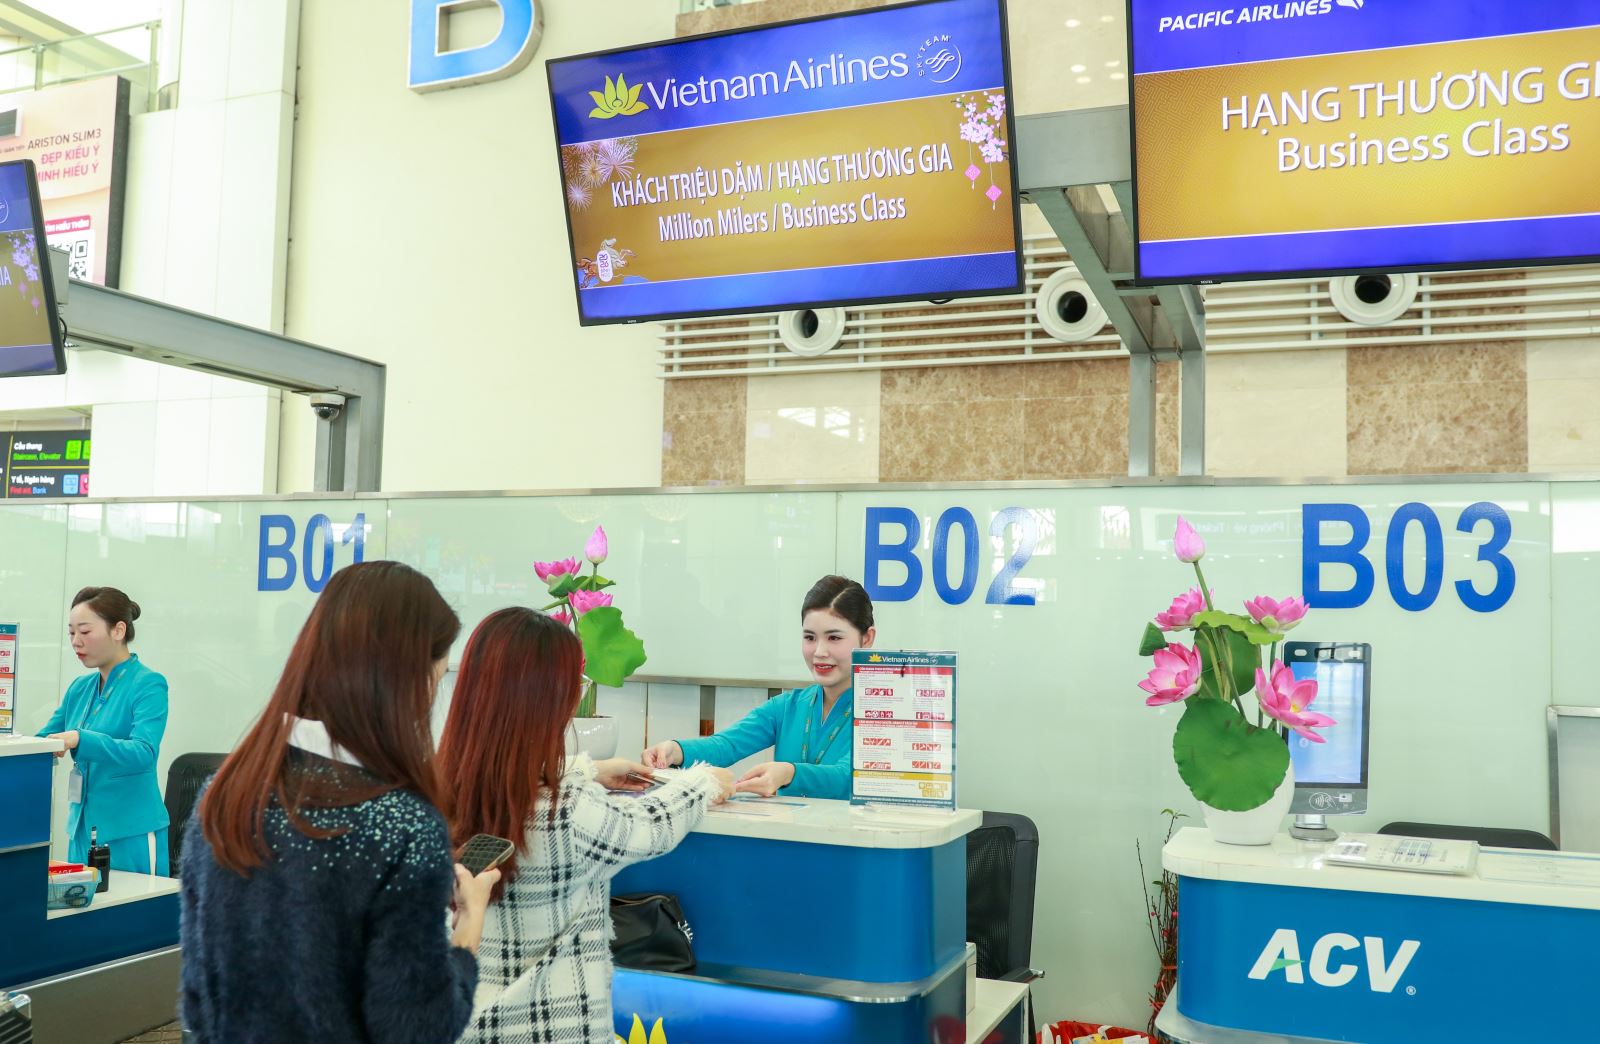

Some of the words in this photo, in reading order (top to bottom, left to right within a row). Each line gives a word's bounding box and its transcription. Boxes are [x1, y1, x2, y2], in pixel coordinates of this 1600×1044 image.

[1159, 9, 1234, 33] PACIFIC
[1236, 0, 1332, 24] AIRLINES
[647, 71, 780, 110] Vietnam
[783, 52, 909, 93] Airlines
[917, 34, 951, 77] SKYTEAM
[1221, 86, 1341, 135] HẠNG
[1349, 67, 1543, 118] THƯƠNG
[28, 134, 70, 150] ARISTON
[72, 128, 102, 143] SLIM3
[1278, 132, 1449, 172] Business
[1462, 118, 1570, 158] Class
[611, 173, 669, 207] KHÁCH
[670, 166, 719, 205] TRIỆU
[721, 160, 763, 200] DẶM
[767, 162, 774, 192] /
[776, 156, 831, 194] HẠNG
[832, 147, 916, 182] THƯƠNG
[919, 143, 954, 173] GIA
[659, 212, 715, 241] Million
[717, 206, 769, 236] Milers
[773, 203, 779, 232] /
[782, 199, 858, 230] Business
[860, 192, 907, 222] Class
[258, 513, 365, 593] B01
[863, 506, 1036, 605] B02
[1302, 501, 1516, 613] B03
[882, 655, 906, 664] Vietnam
[907, 655, 930, 664] Airlines
